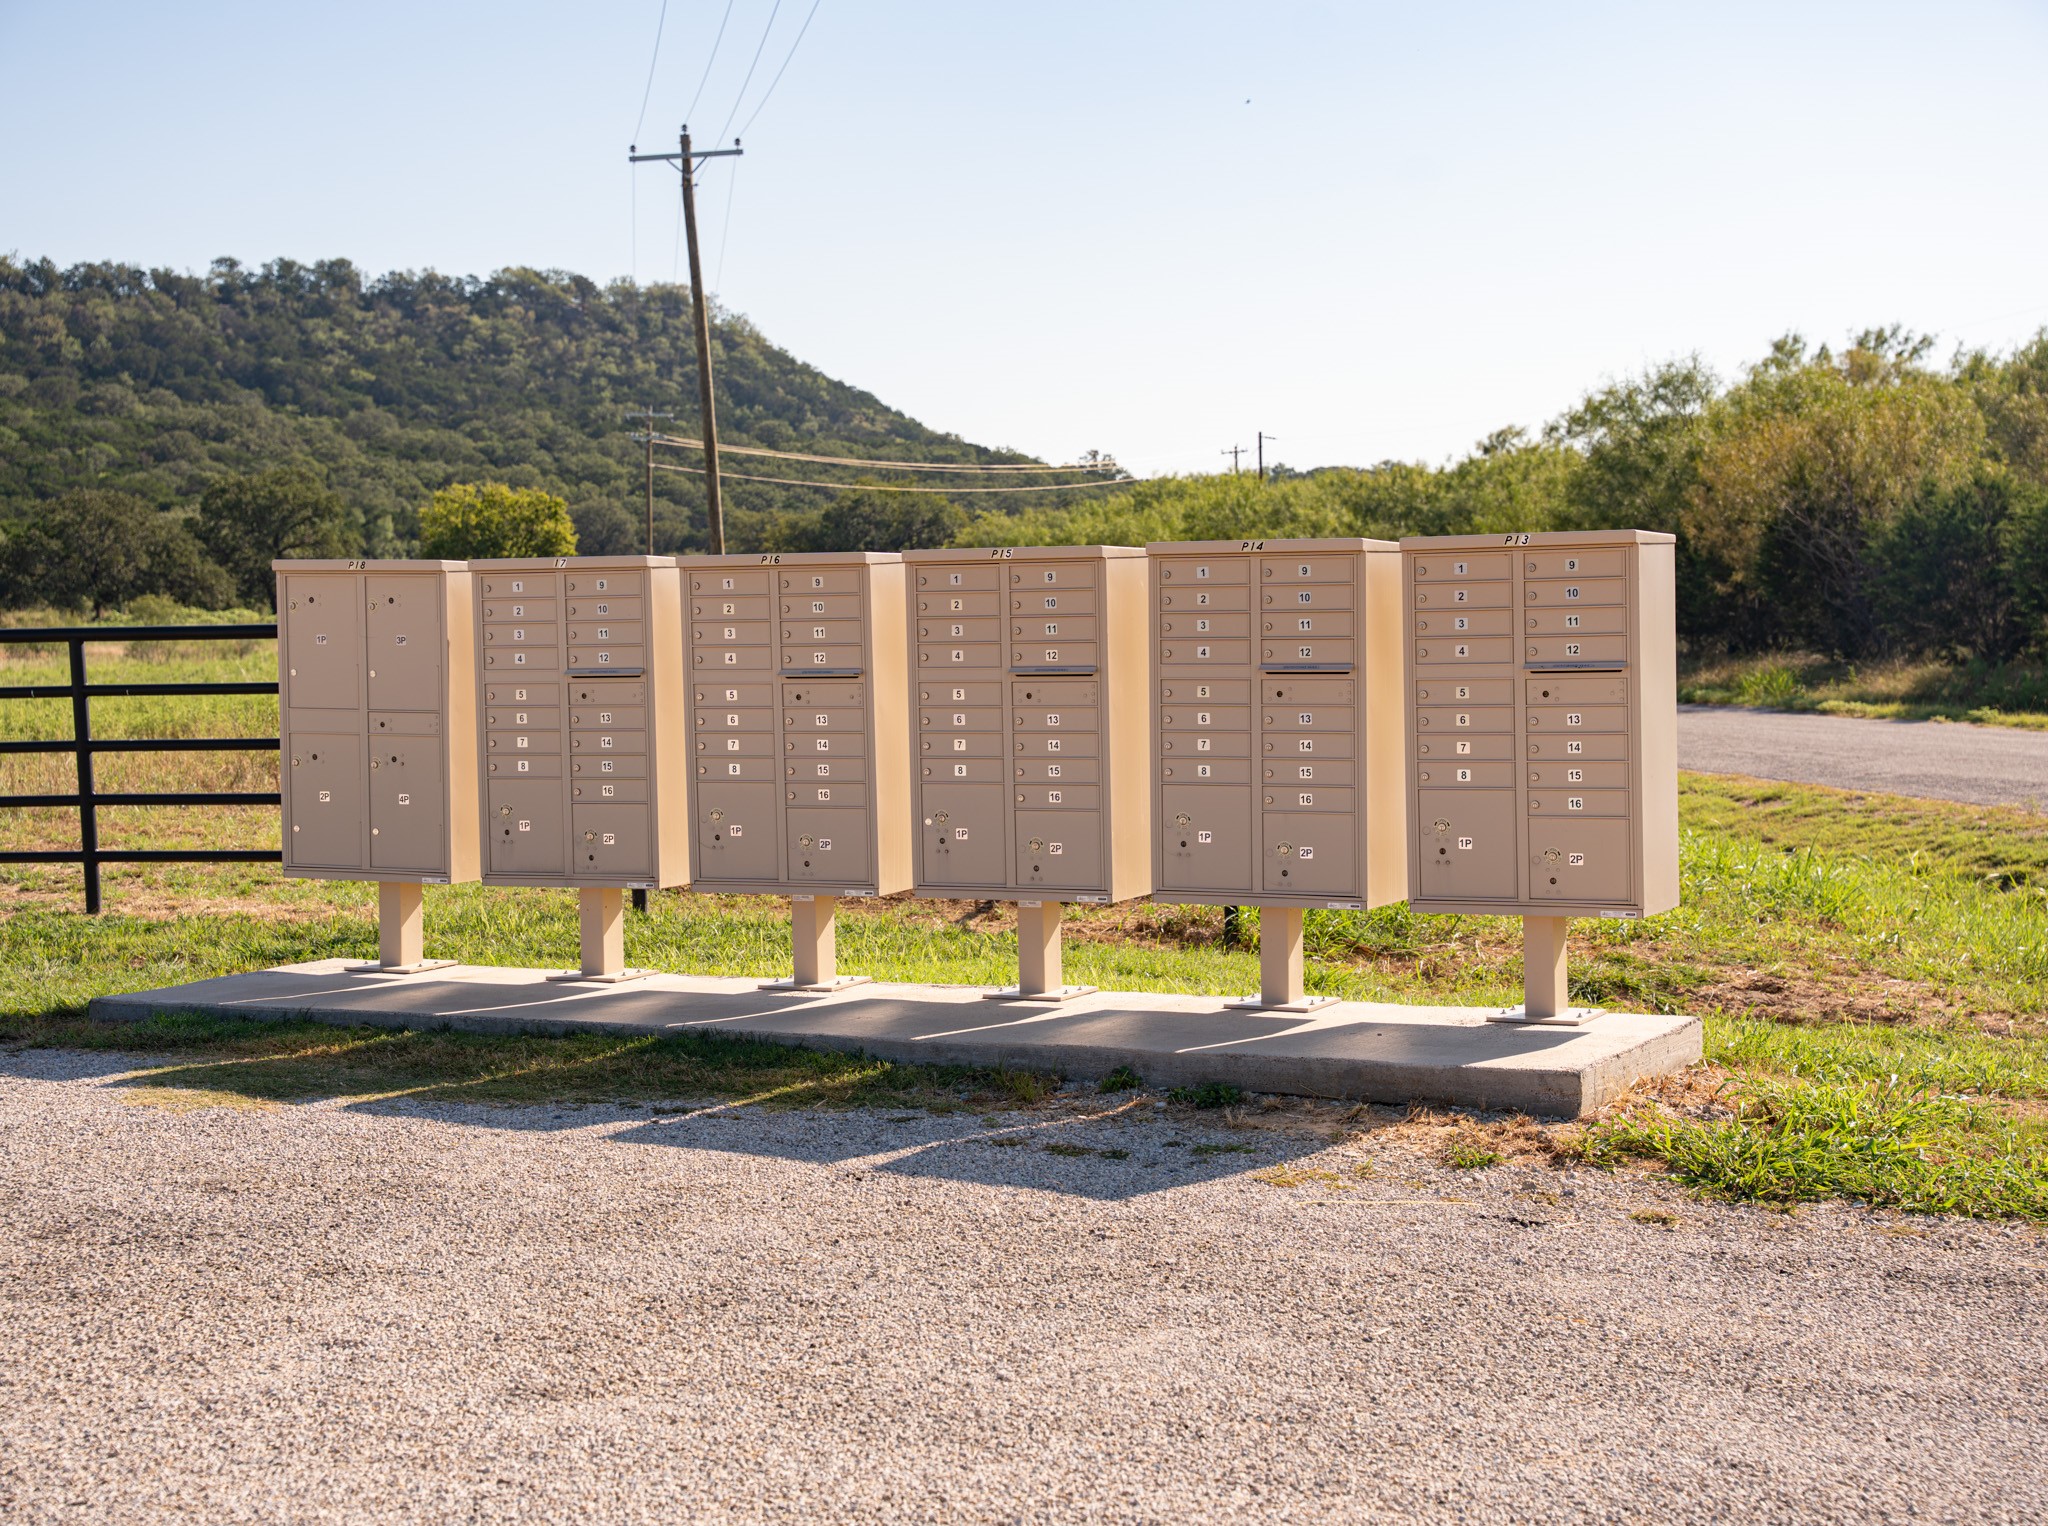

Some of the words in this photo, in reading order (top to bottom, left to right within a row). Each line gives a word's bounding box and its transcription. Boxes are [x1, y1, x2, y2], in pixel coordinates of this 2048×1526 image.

[1299, 592, 1311, 602] 10
[1566, 588, 1579, 598] 10
[813, 602, 824, 611] 10
[1045, 598, 1056, 607] 10
[598, 604, 608, 613] 10
[1300, 620, 1310, 629] 11
[1567, 616, 1578, 626] 11
[599, 629, 608, 637] 11
[815, 628, 824, 636] 11
[1046, 624, 1056, 633] 11
[316, 635, 327, 643] 1P
[396, 636, 406, 644] 3P
[1299, 647, 1311, 657] 12
[1567, 644, 1579, 654] 12
[599, 653, 609, 662] 12
[815, 653, 825, 662] 12
[1046, 650, 1057, 660] 12
[601, 713, 611, 722] 13
[817, 715, 827, 724] 13
[1048, 715, 1059, 724] 13
[1300, 714, 1311, 723] 13
[1568, 714, 1580, 724] 13
[1049, 741, 1059, 749] 14
[1300, 741, 1312, 750] 14
[1568, 742, 1580, 752] 14
[603, 762, 612, 770] 15
[818, 766, 828, 774] 15
[1049, 766, 1060, 775] 15
[1300, 768, 1312, 777] 15
[1569, 770, 1581, 780] 15
[604, 786, 613, 794] 16
[819, 790, 829, 799] 16
[1050, 792, 1060, 801] 16
[1300, 795, 1312, 804] 16
[1569, 799, 1582, 808] 16
[956, 829, 967, 838] 1P
[1199, 832, 1211, 841] 1P
[820, 840, 831, 848] 2P
[1459, 838, 1472, 847] 1P
[1050, 844, 1062, 852] 2P
[1300, 848, 1312, 857] 2P
[1570, 854, 1583, 864] 2P
